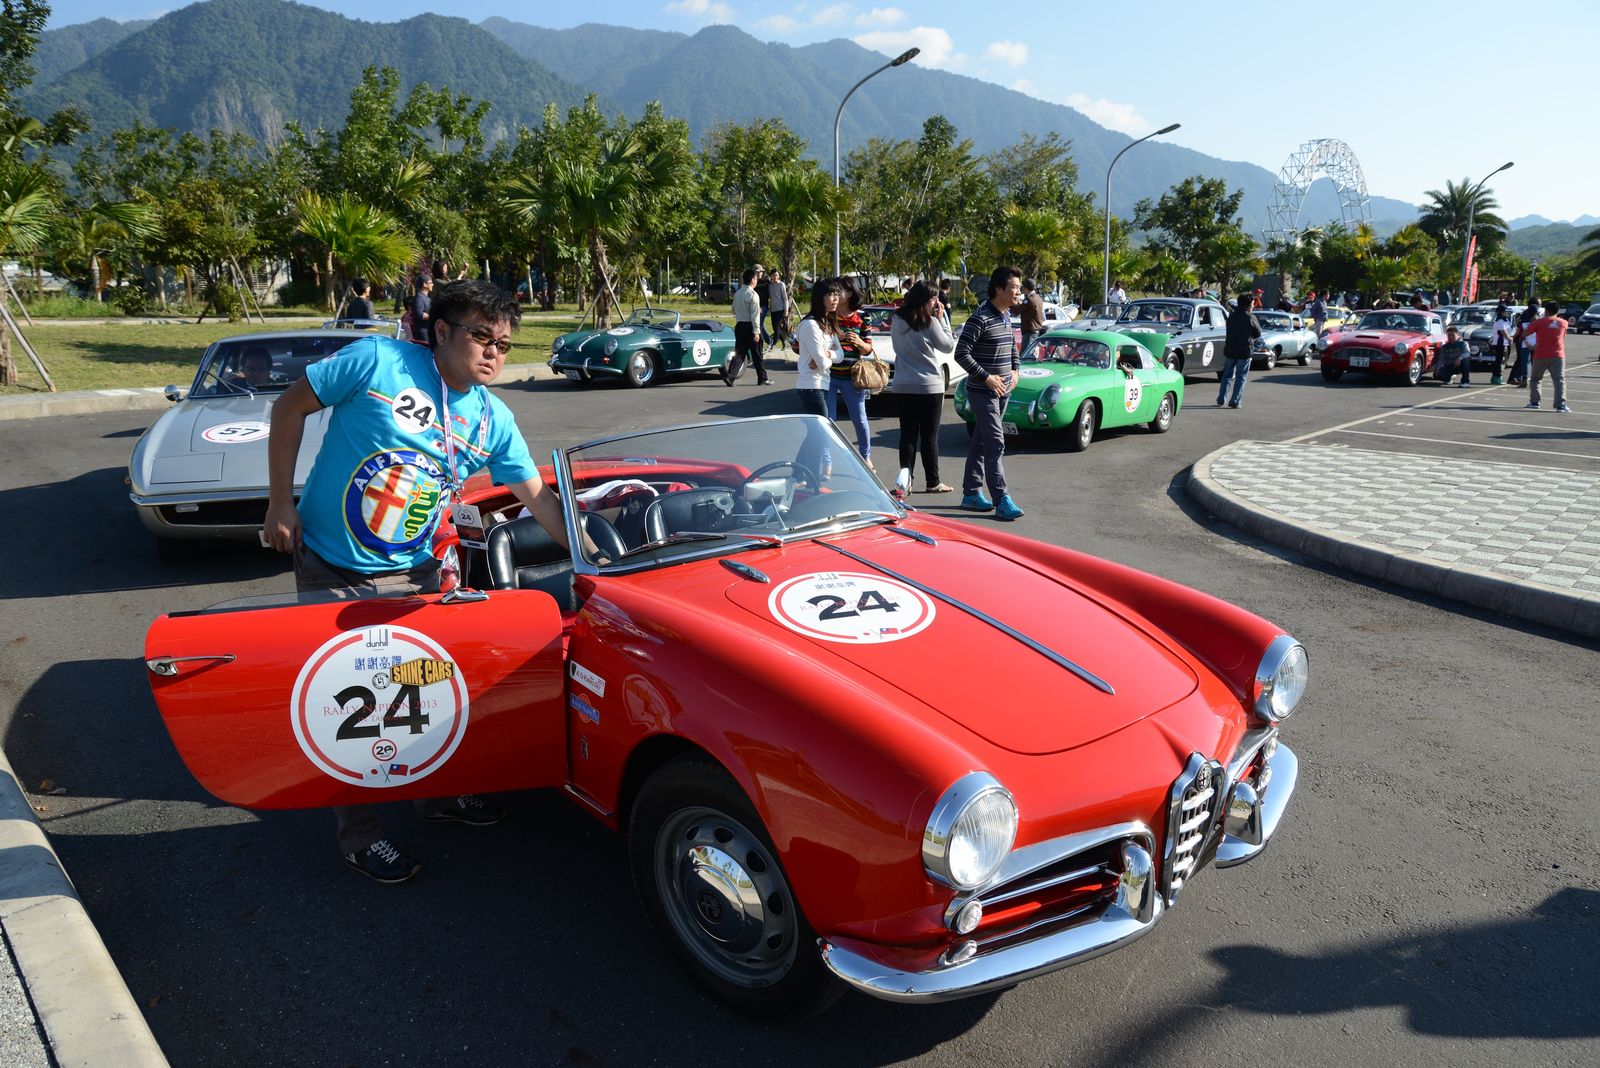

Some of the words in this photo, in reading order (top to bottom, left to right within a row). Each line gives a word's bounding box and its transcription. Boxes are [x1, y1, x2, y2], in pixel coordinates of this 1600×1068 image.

[1130, 388, 1138, 400] 39
[395, 395, 432, 427] 24
[218, 427, 261, 436] 57
[353, 452, 405, 493] ALFA
[806, 590, 901, 621] 24
[366, 629, 388, 647] dunhill
[393, 659, 424, 685] SHINE
[425, 660, 452, 683] CARS
[323, 705, 359, 716] RALLY
[414, 699, 437, 710] 2013
[333, 685, 430, 742] 24
